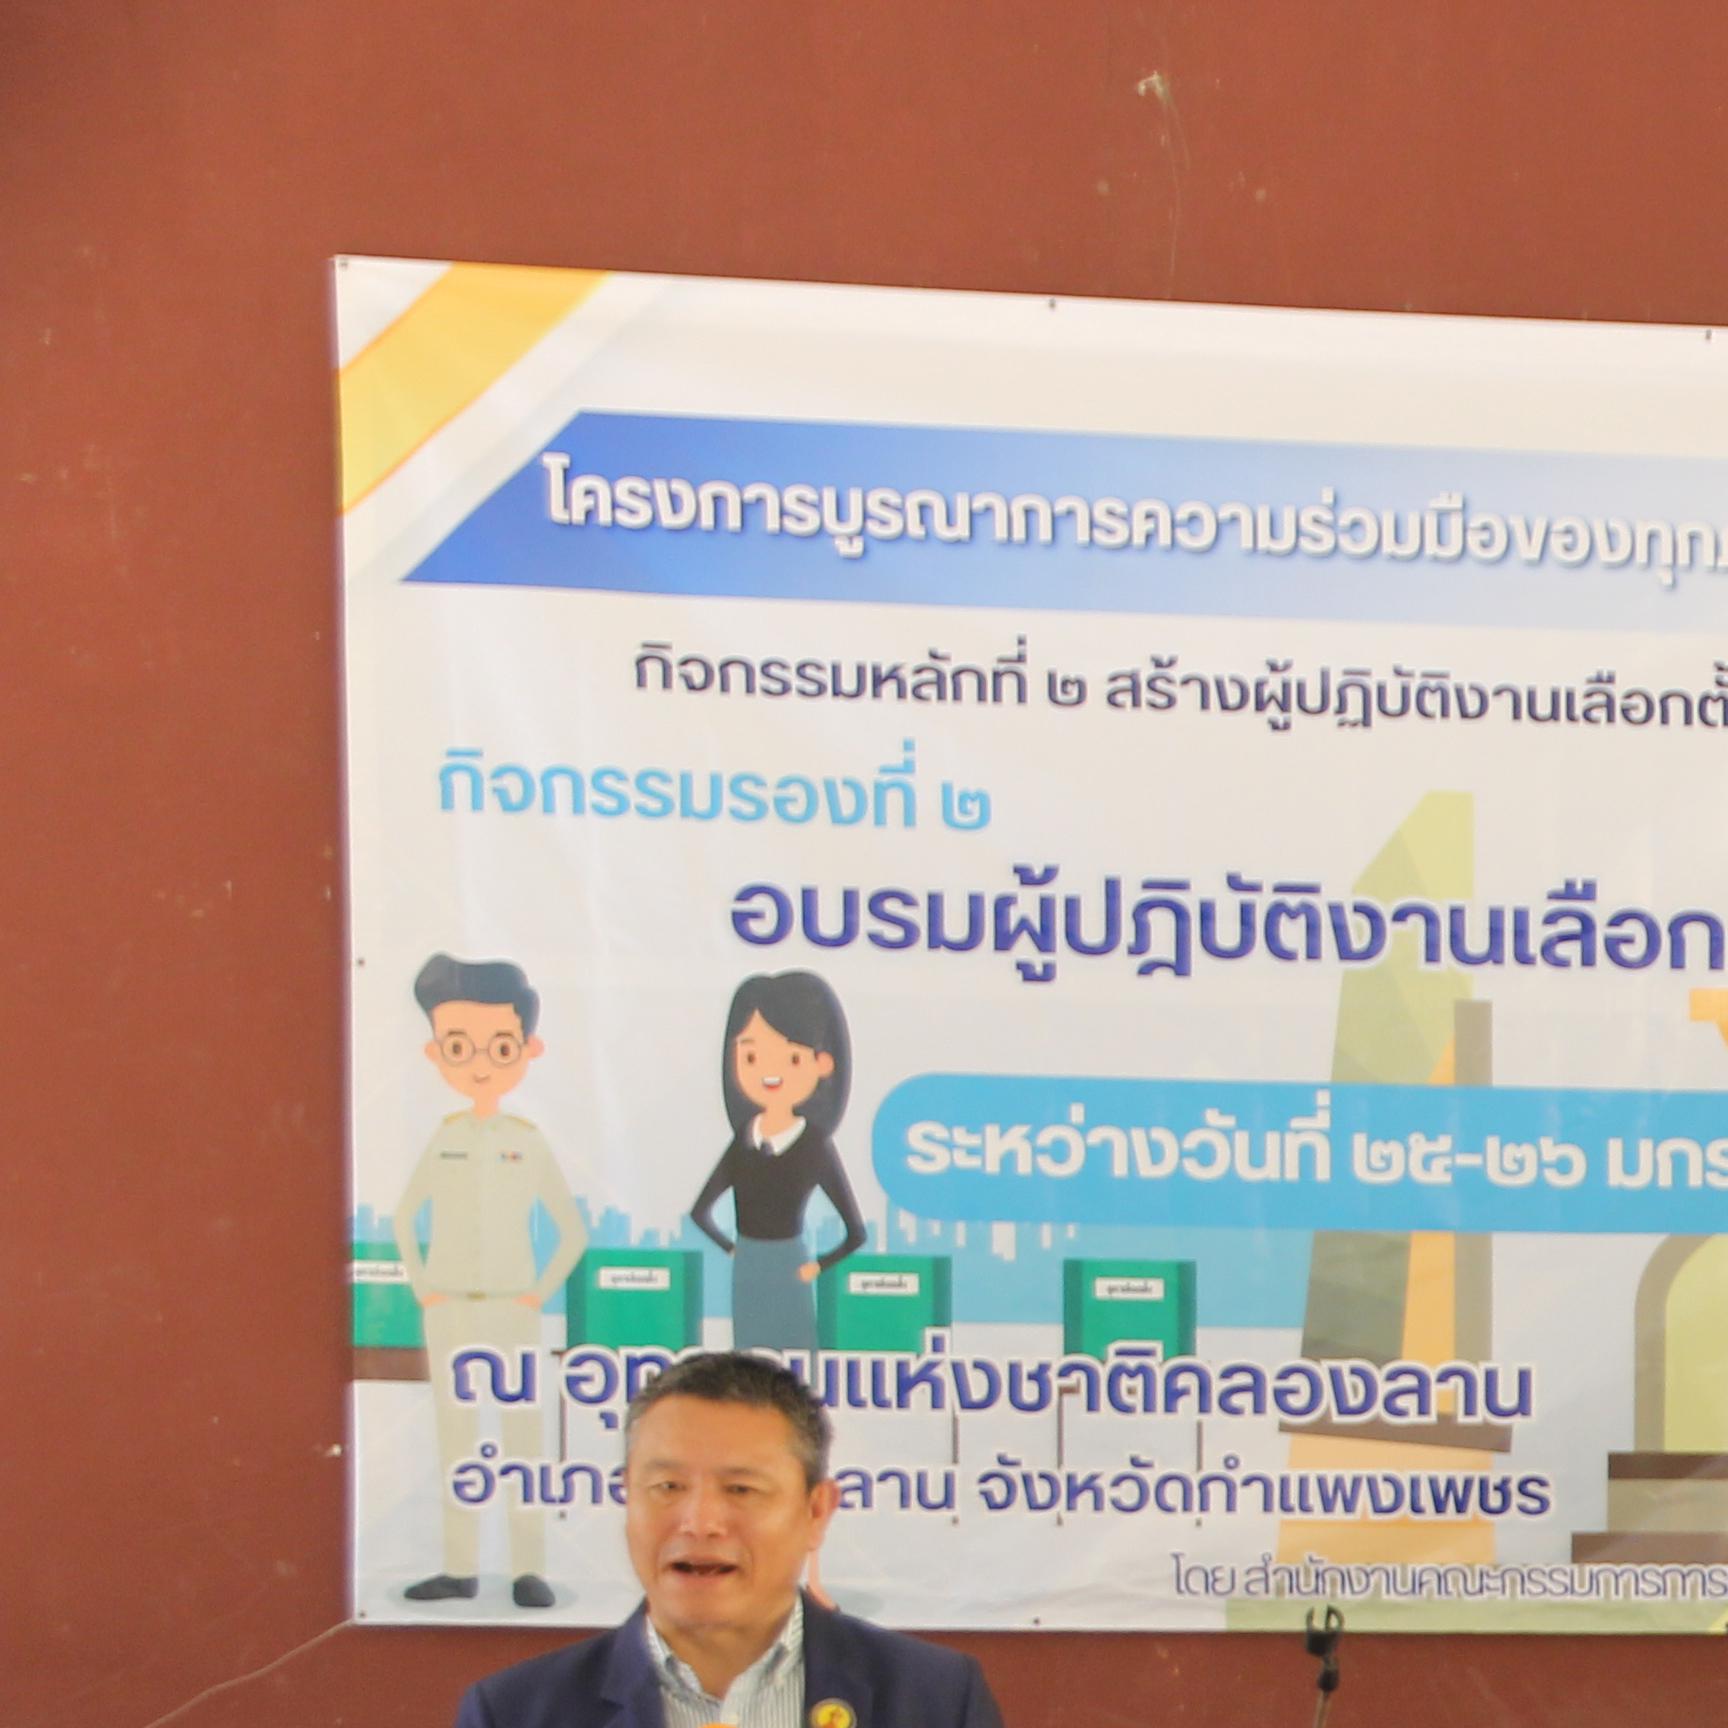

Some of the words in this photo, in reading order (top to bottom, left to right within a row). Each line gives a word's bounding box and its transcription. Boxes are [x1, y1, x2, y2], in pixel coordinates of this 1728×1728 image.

[633, 636, 1028, 706] กิจกรรมหลักที่
[1047, 666, 1087, 708] ๒
[437, 739, 918, 828] กิจกรรมรองที่
[939, 782, 994, 832] ๒
[904, 1089, 1331, 1182] ระหว่างวันที่
[1351, 1130, 1587, 1189] ๒๕-๒๖
[451, 1348, 537, 1403] ณ
[977, 1452, 1552, 1518] จังหวัดกำแพงเพชร
[1171, 1553, 1237, 1597] โดย
